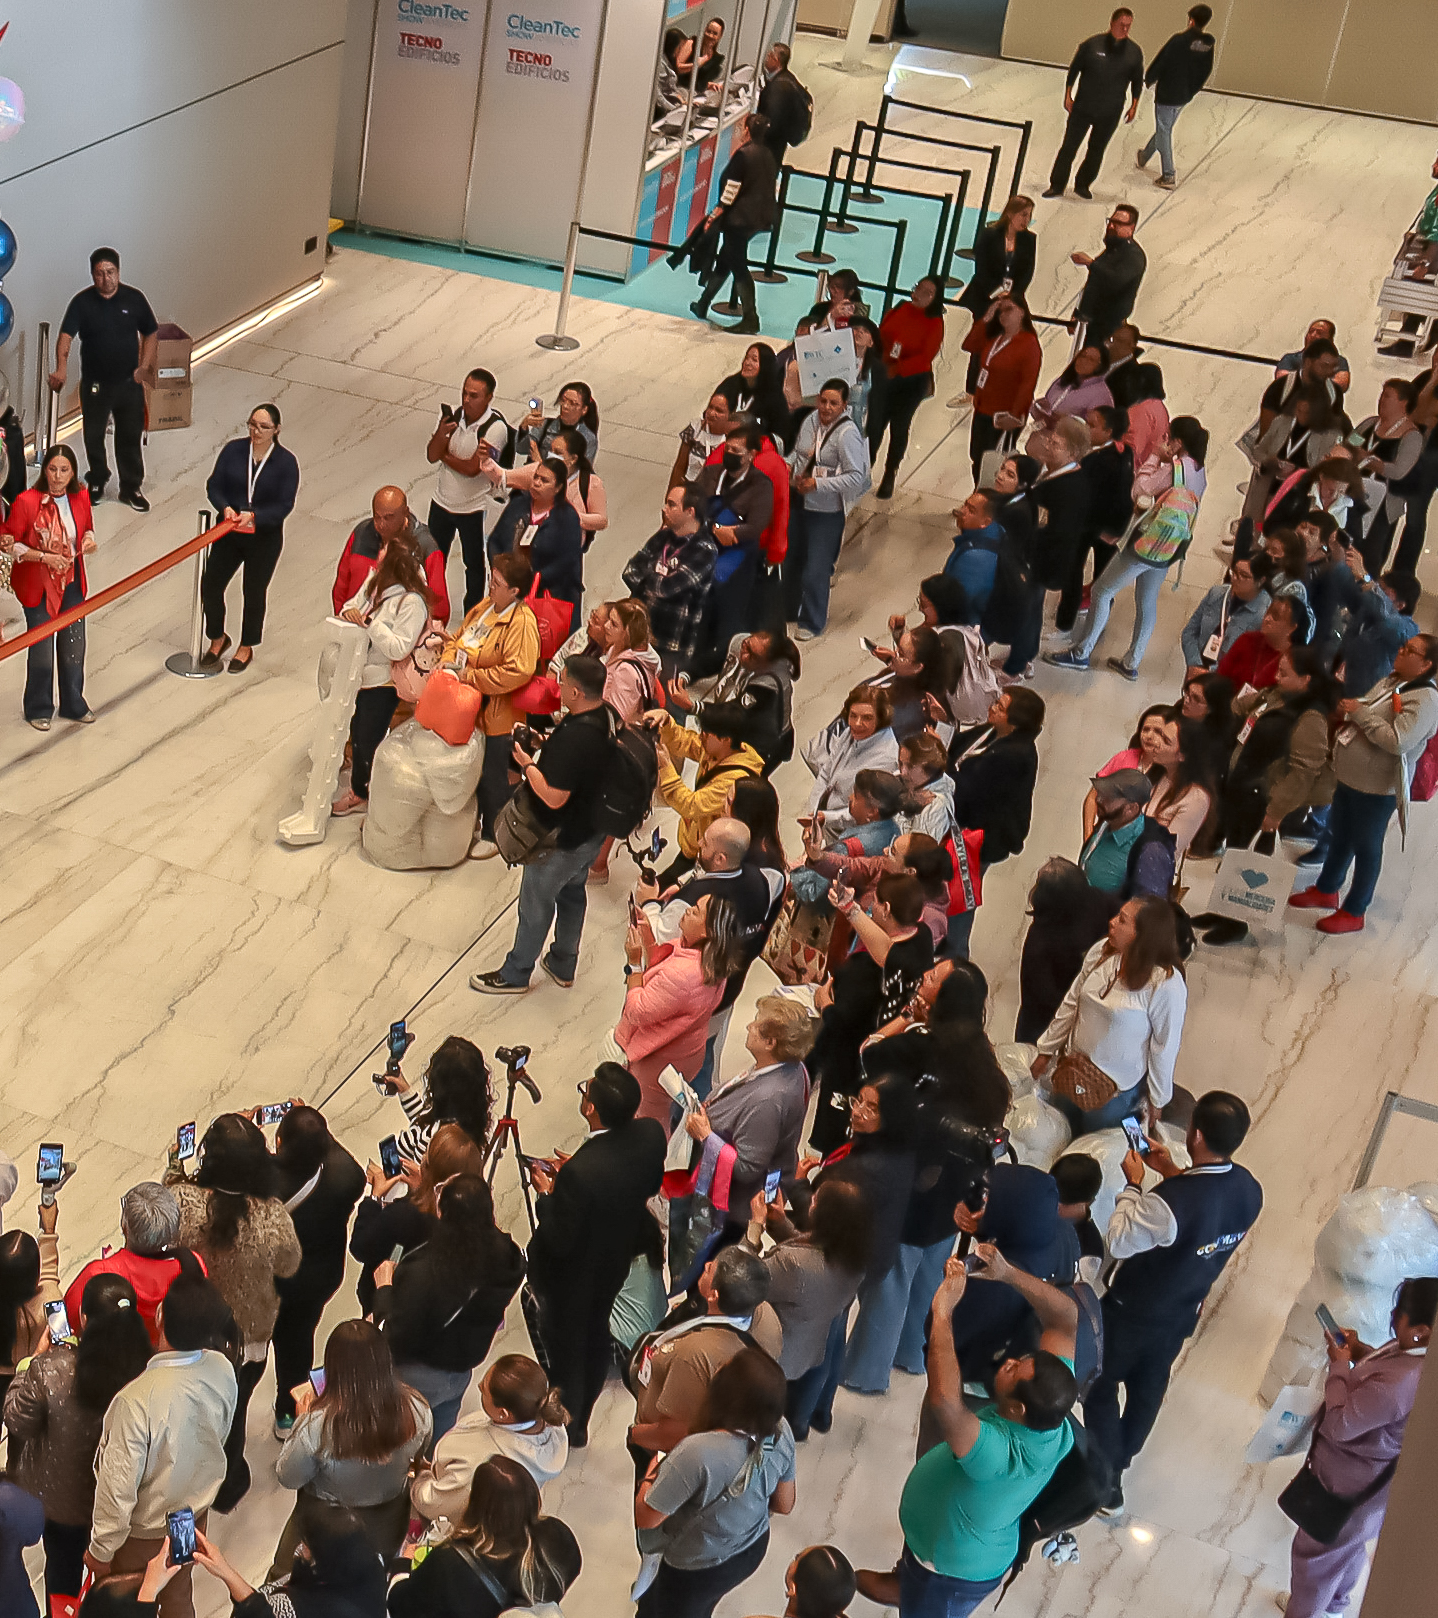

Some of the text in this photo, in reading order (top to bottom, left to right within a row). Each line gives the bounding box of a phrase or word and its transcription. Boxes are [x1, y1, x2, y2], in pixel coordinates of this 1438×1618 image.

[398, 0, 469, 22] CleanTec
[507, 14, 580, 39] CleanTec
[400, 32, 443, 50] TECNO
[398, 45, 460, 66] EDIFICIOS
[508, 48, 552, 67] TECNO
[506, 61, 569, 83] EDIFICIOS
